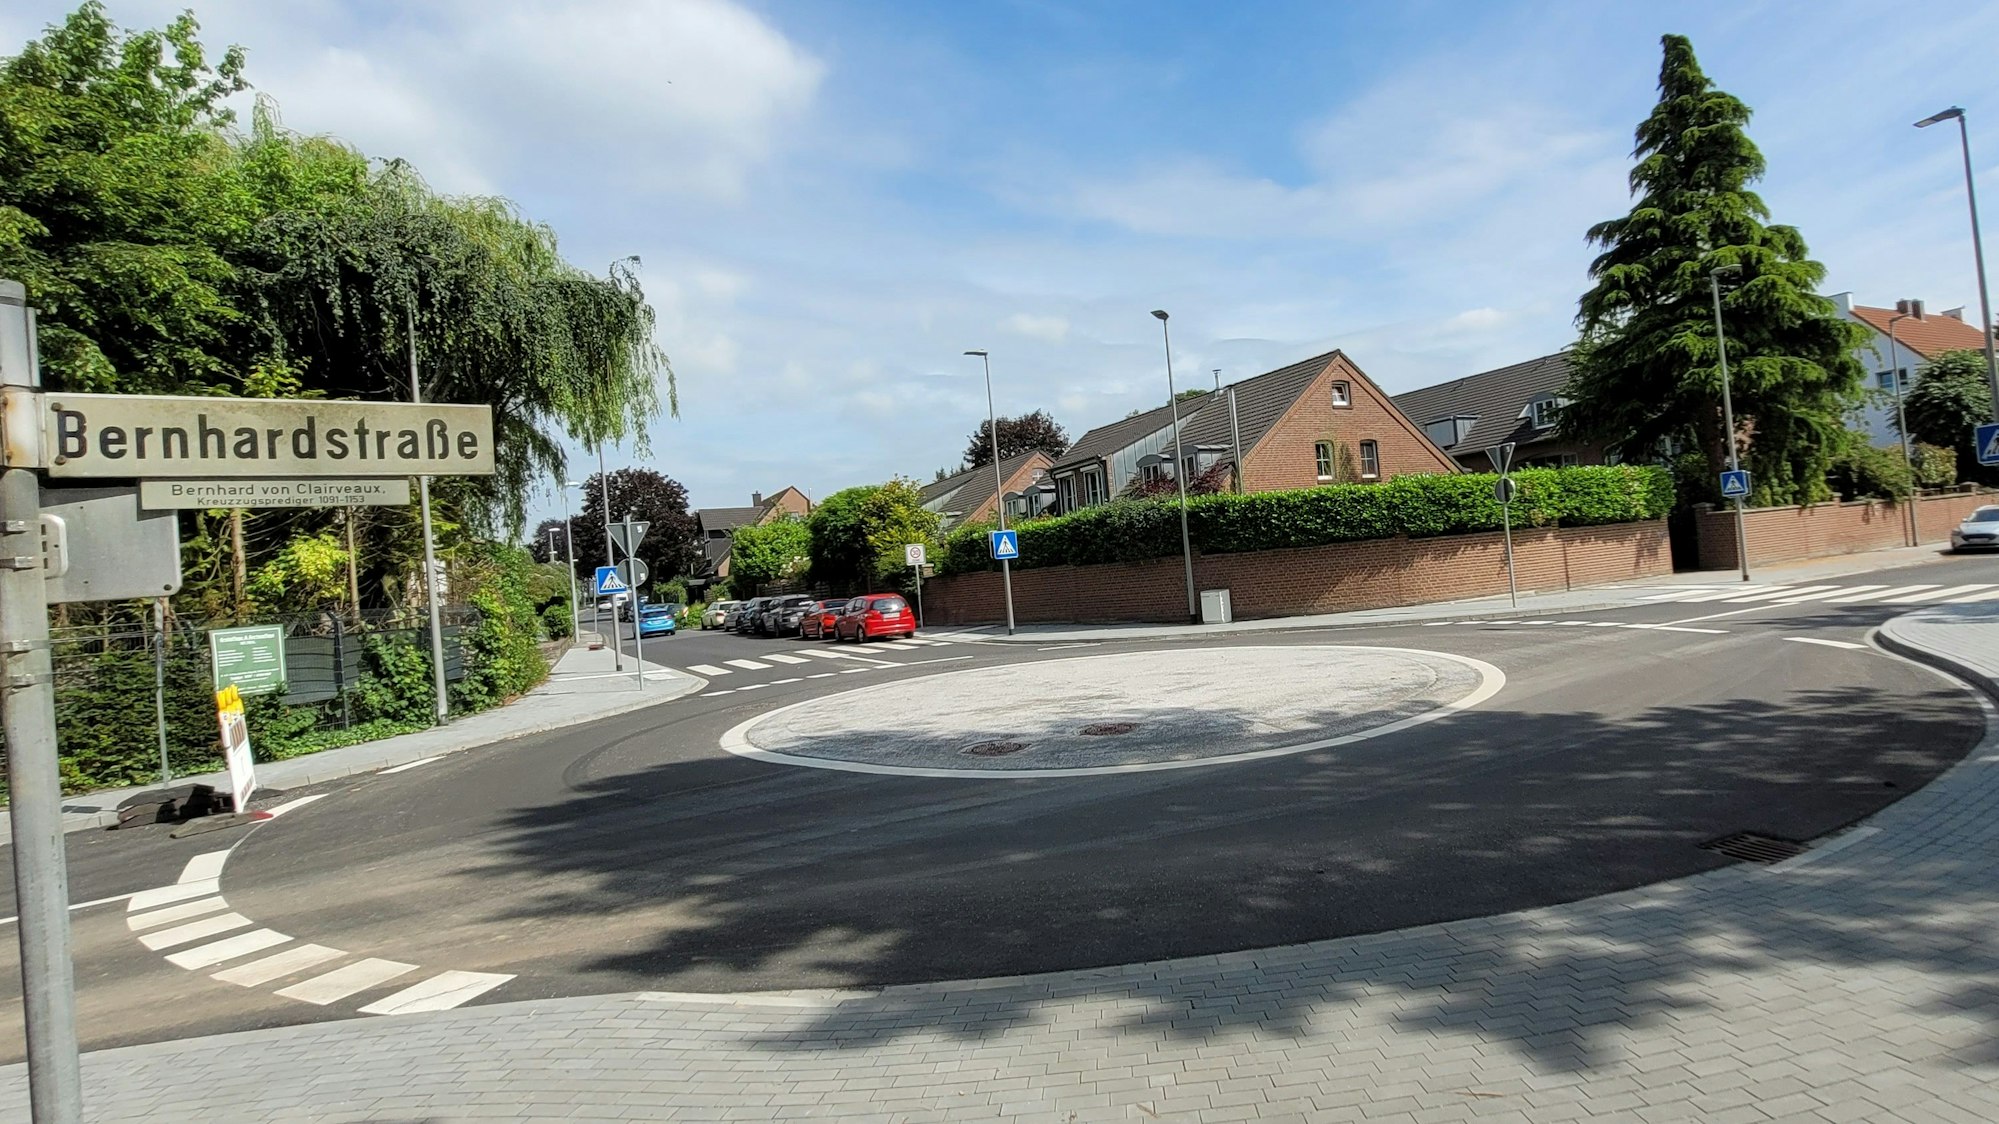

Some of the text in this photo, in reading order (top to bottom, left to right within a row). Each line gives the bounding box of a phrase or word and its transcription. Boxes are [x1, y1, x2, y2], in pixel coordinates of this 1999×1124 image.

[58, 410, 479, 460] Bernhardstraße
[171, 484, 254, 496] Bernhard
[261, 486, 290, 495] von
[197, 495, 365, 506] Kreuzzugsprediger 1091-1153
